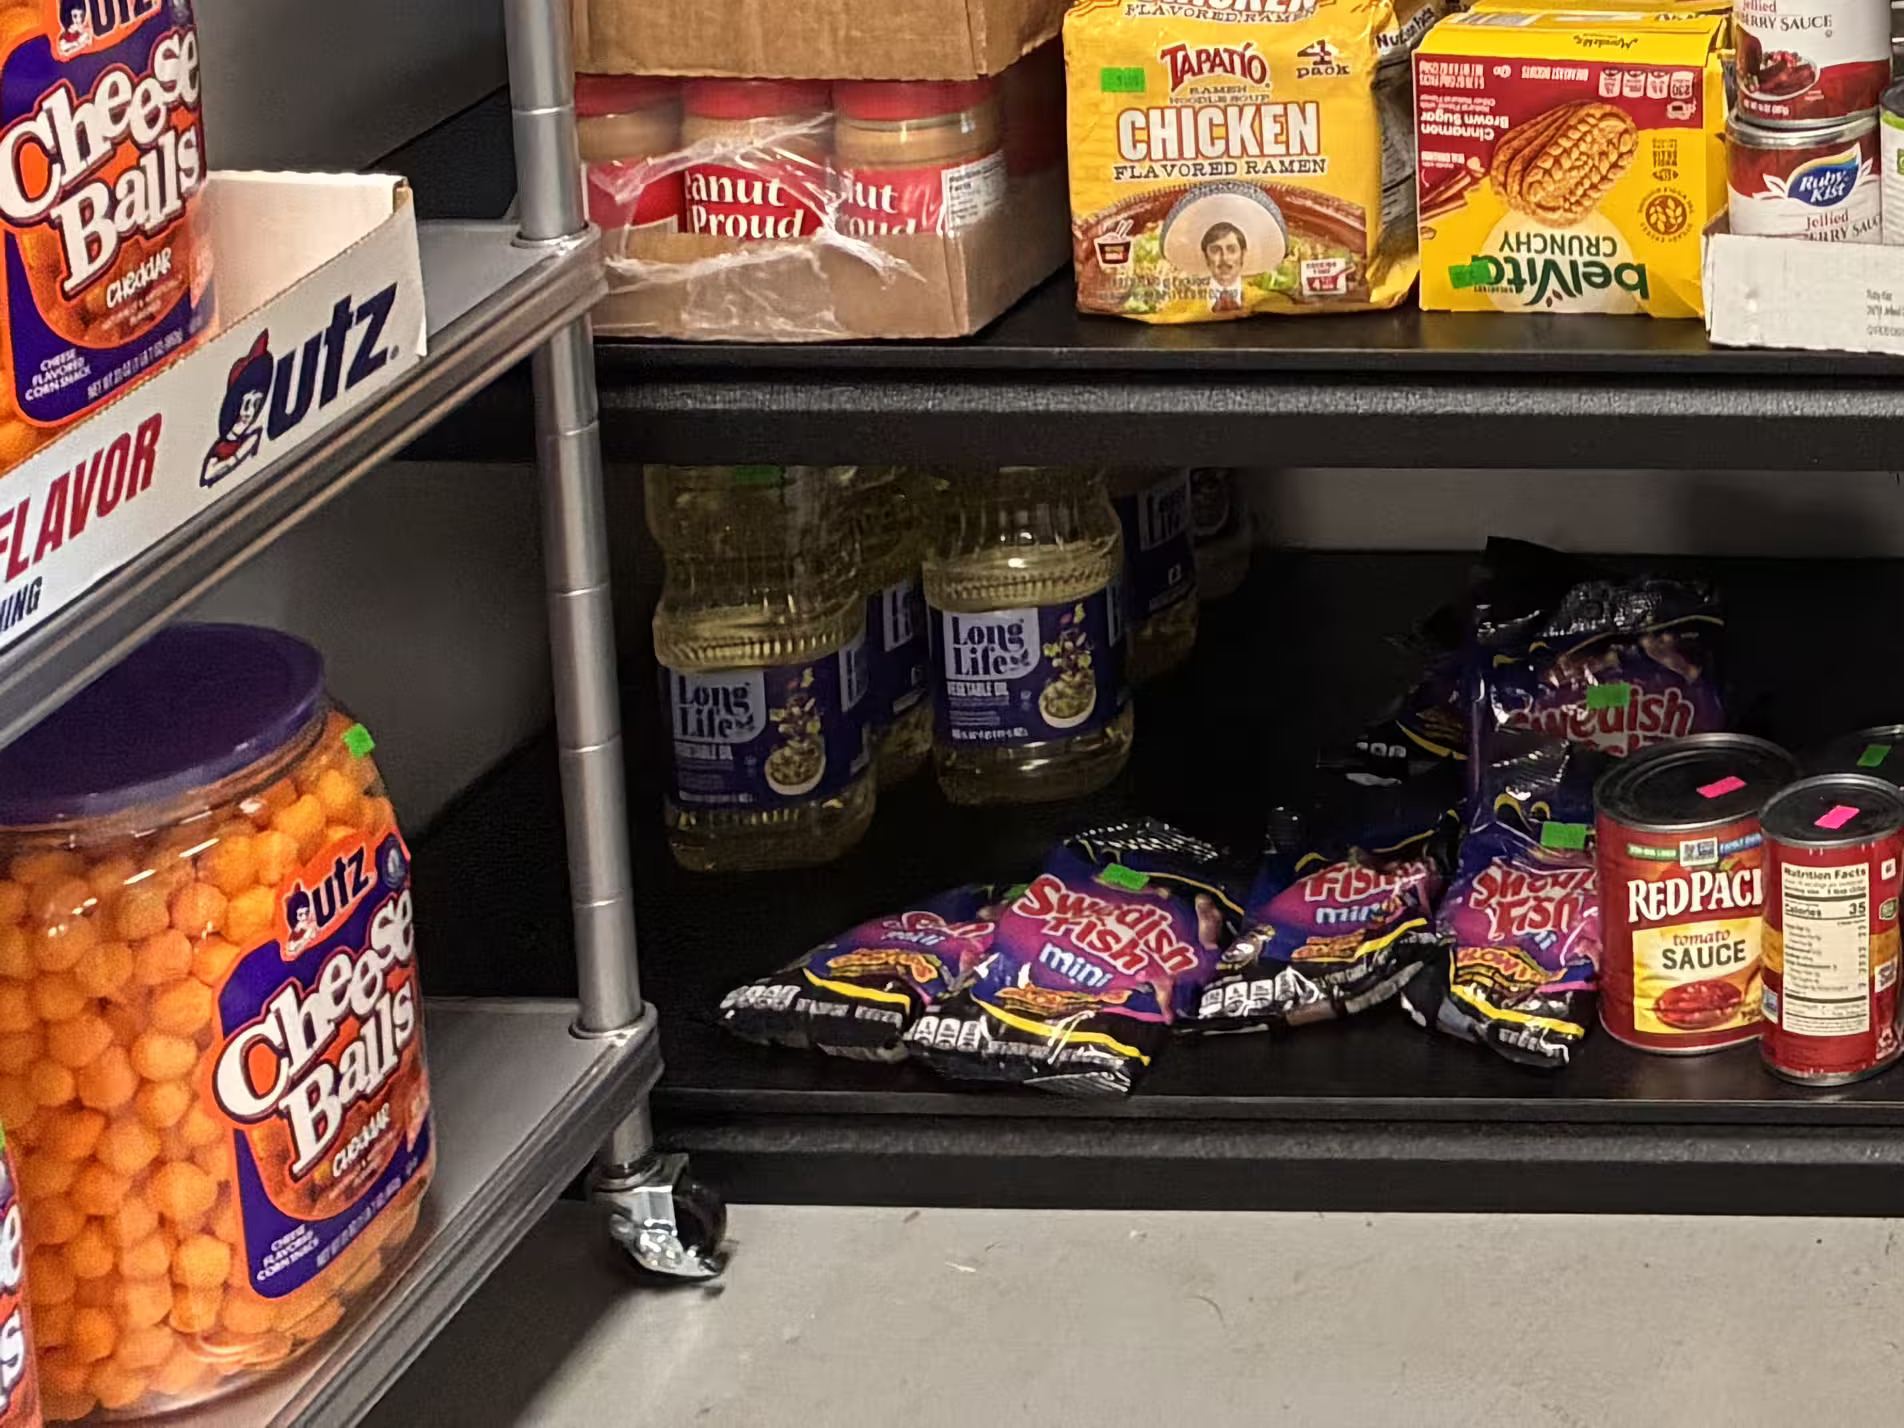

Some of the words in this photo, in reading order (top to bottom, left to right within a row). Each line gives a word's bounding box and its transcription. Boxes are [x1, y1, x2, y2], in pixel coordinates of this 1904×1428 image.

[1119, 102, 1320, 162] CHICKEN
[1113, 161, 1239, 181] FLAVORED
[1245, 158, 1327, 177] RAMEN
[59, 124, 200, 294] Balls
[1499, 231, 1619, 256] CRUNCHY
[1673, 927, 1731, 945] tomato
[1662, 941, 1746, 969] SAUCE
